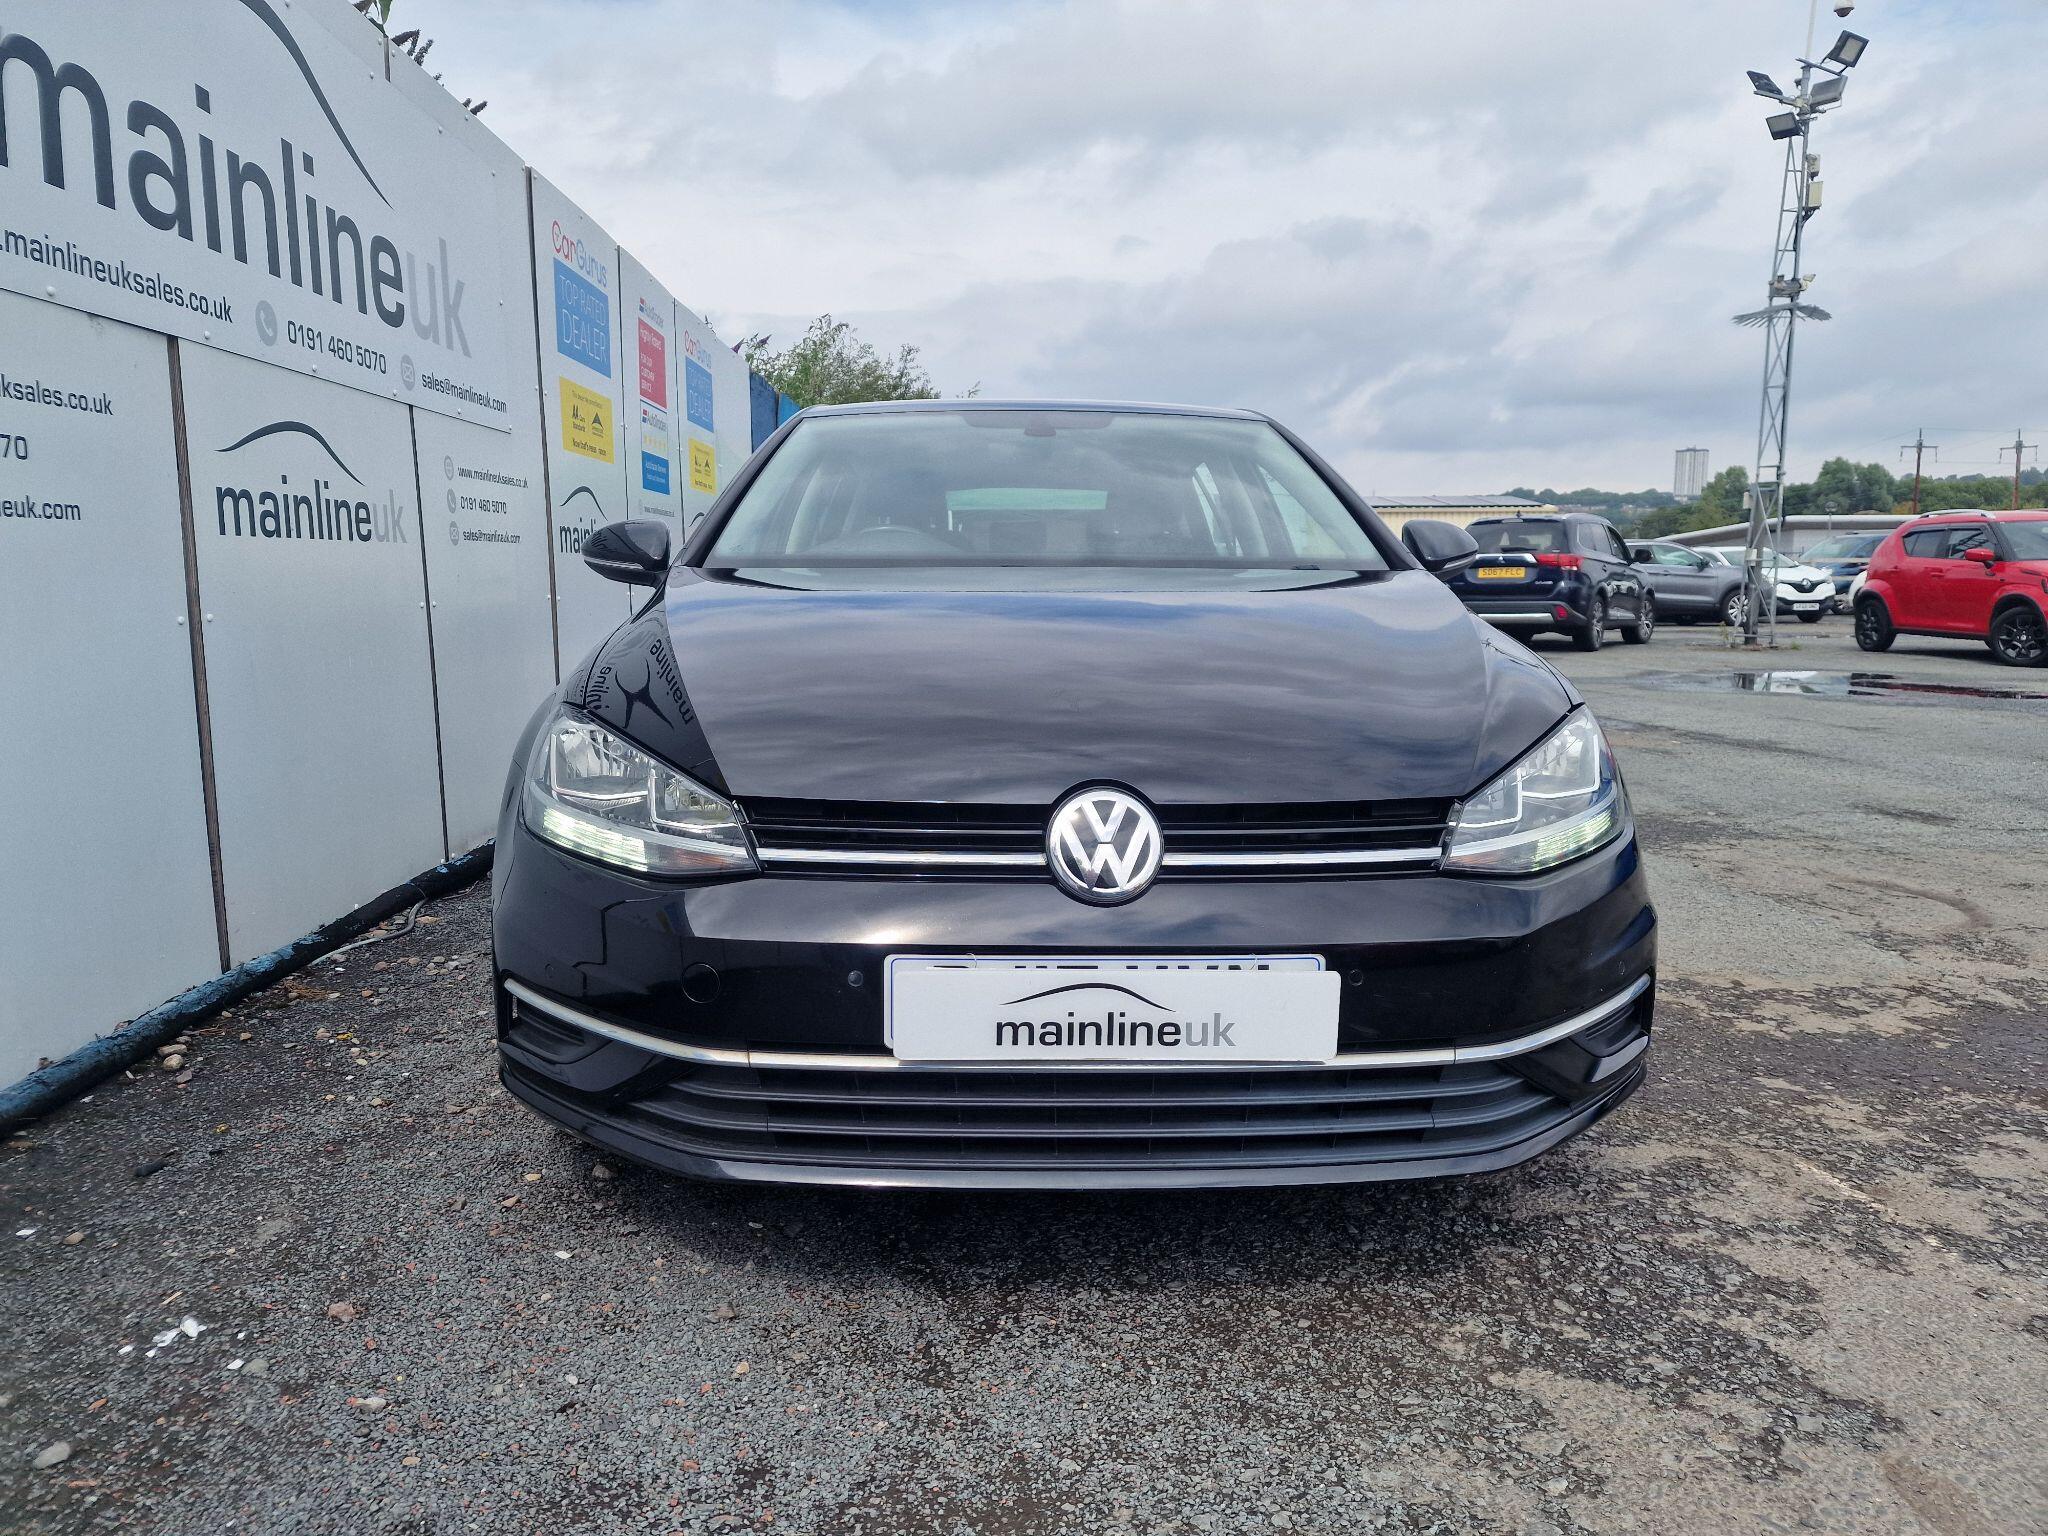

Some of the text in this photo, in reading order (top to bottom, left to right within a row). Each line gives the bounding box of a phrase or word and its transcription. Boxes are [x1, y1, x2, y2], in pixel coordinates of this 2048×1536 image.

[0, 33, 471, 359] mainlineuk
[552, 220, 607, 287] CarGurus
[560, 275, 578, 307] TOP
[580, 289, 606, 326] RATED
[287, 320, 387, 375] 0191 460 5070
[562, 309, 607, 363] DEALER
[421, 371, 507, 414] sales@mainlineuk.com
[215, 475, 407, 545] mainlineuk
[460, 496, 507, 514] 0191 460 5070
[995, 1012, 1236, 1048] mainlineuk
